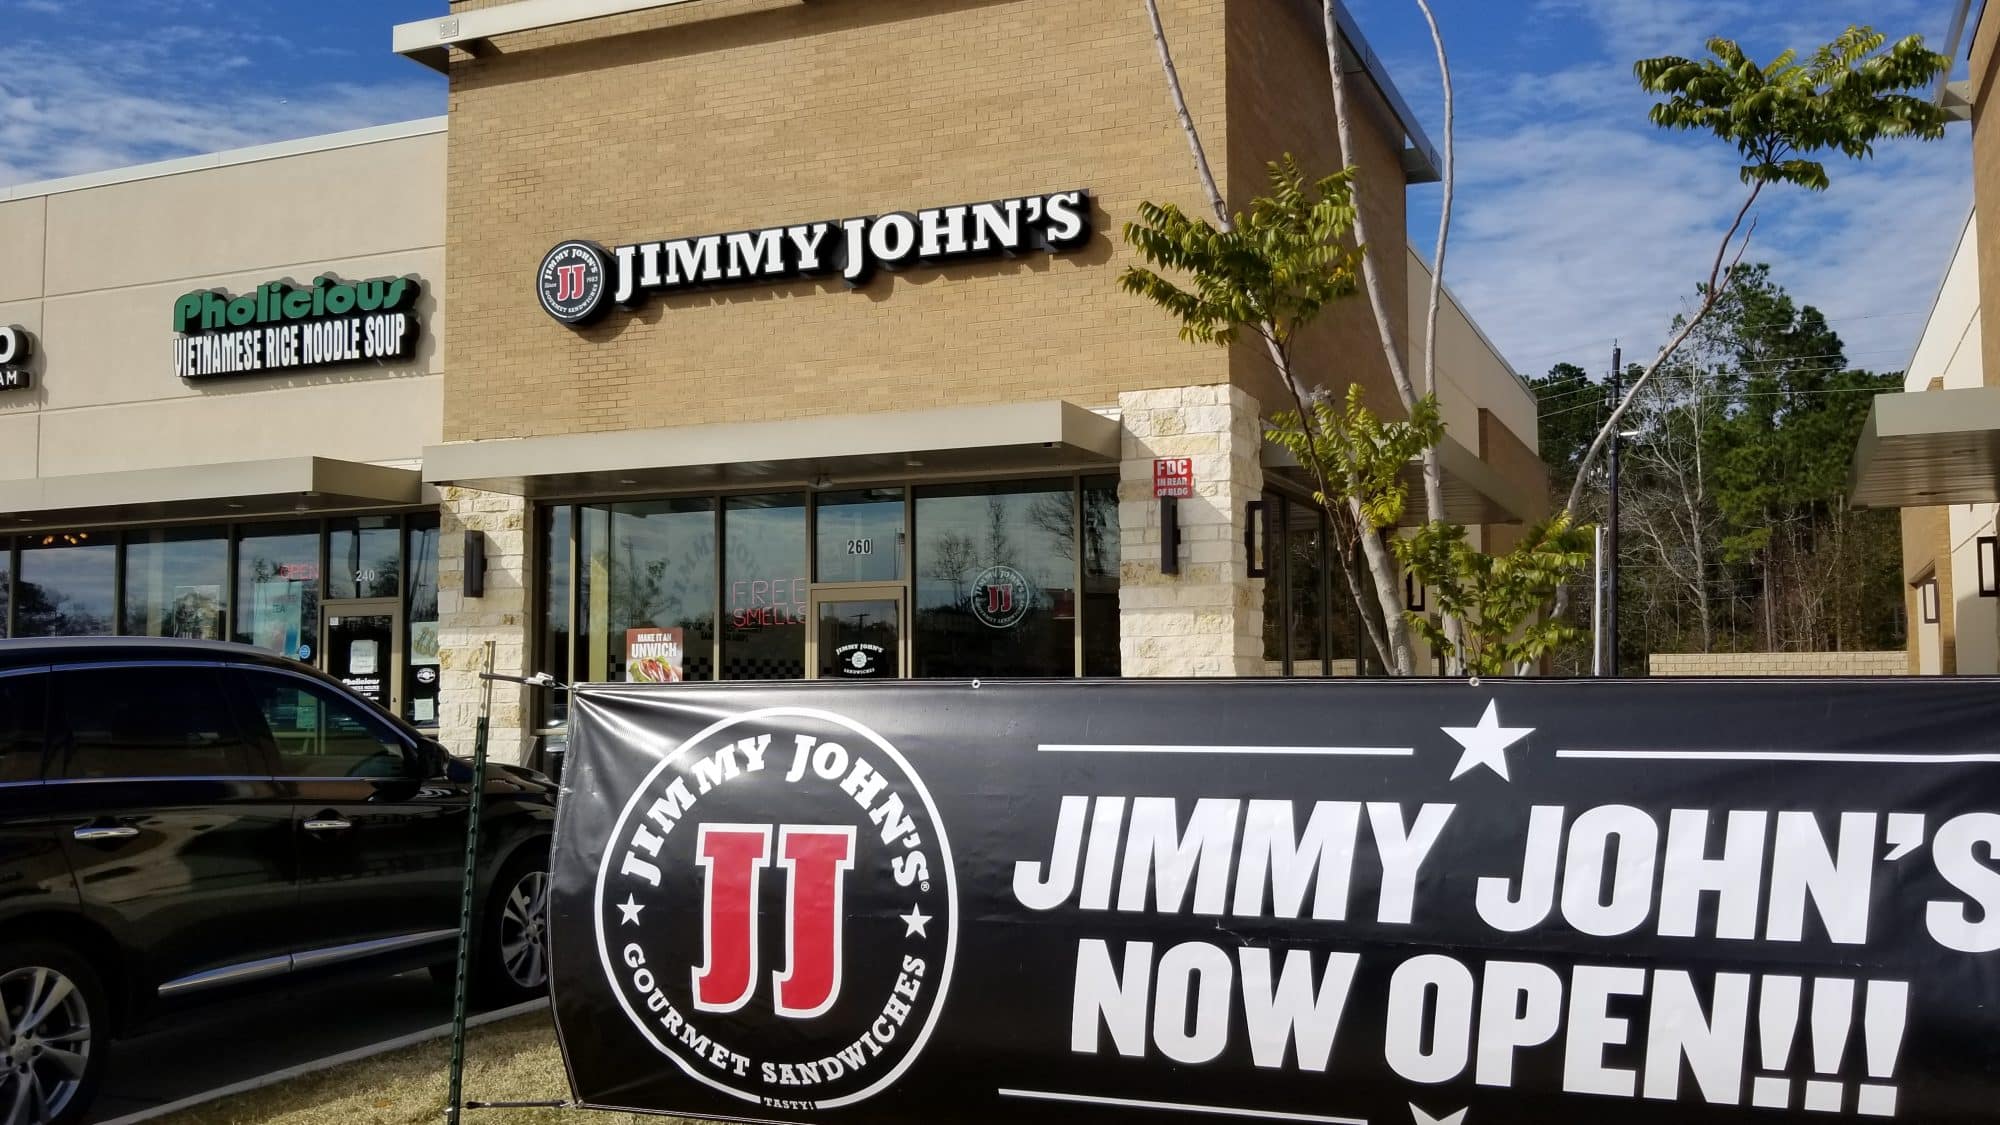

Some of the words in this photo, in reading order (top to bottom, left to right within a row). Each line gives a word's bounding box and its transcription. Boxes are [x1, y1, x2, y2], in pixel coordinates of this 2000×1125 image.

[615, 223, 830, 302] JIMMY
[842, 191, 1082, 280] JOHN'S
[544, 249, 569, 280] JIMMY
[571, 248, 598, 274] JOHN'S
[557, 263, 586, 302] JJ
[173, 276, 408, 332] Pholicious
[173, 329, 262, 377] VIETNAMESE
[265, 325, 299, 369] RICE
[303, 317, 361, 365] NOODLE
[364, 312, 406, 358] SOUP
[1156, 459, 1188, 476] FDC
[847, 539, 871, 555] 260
[355, 569, 375, 582] 240
[732, 576, 807, 605] FREE
[987, 583, 1013, 613] JJ
[733, 605, 807, 628] SMELLS
[631, 642, 677, 658] UNWICH
[637, 632, 656, 642] MAKE
[655, 632, 663, 642] IT
[663, 632, 672, 642] AN
[620, 733, 772, 888] JIMMY
[786, 733, 930, 888] JOHN'S
[1012, 794, 1457, 925] JIMMY
[1474, 803, 2000, 954] JOHN'S
[691, 822, 858, 1019] JJ
[623, 942, 750, 1078] GOURMET
[761, 954, 926, 1086] SANDWICHES
[1069, 938, 1361, 1073] NOW
[1384, 954, 1911, 1118] OPEN!!!
[763, 1096, 815, 1111] TASTY!
